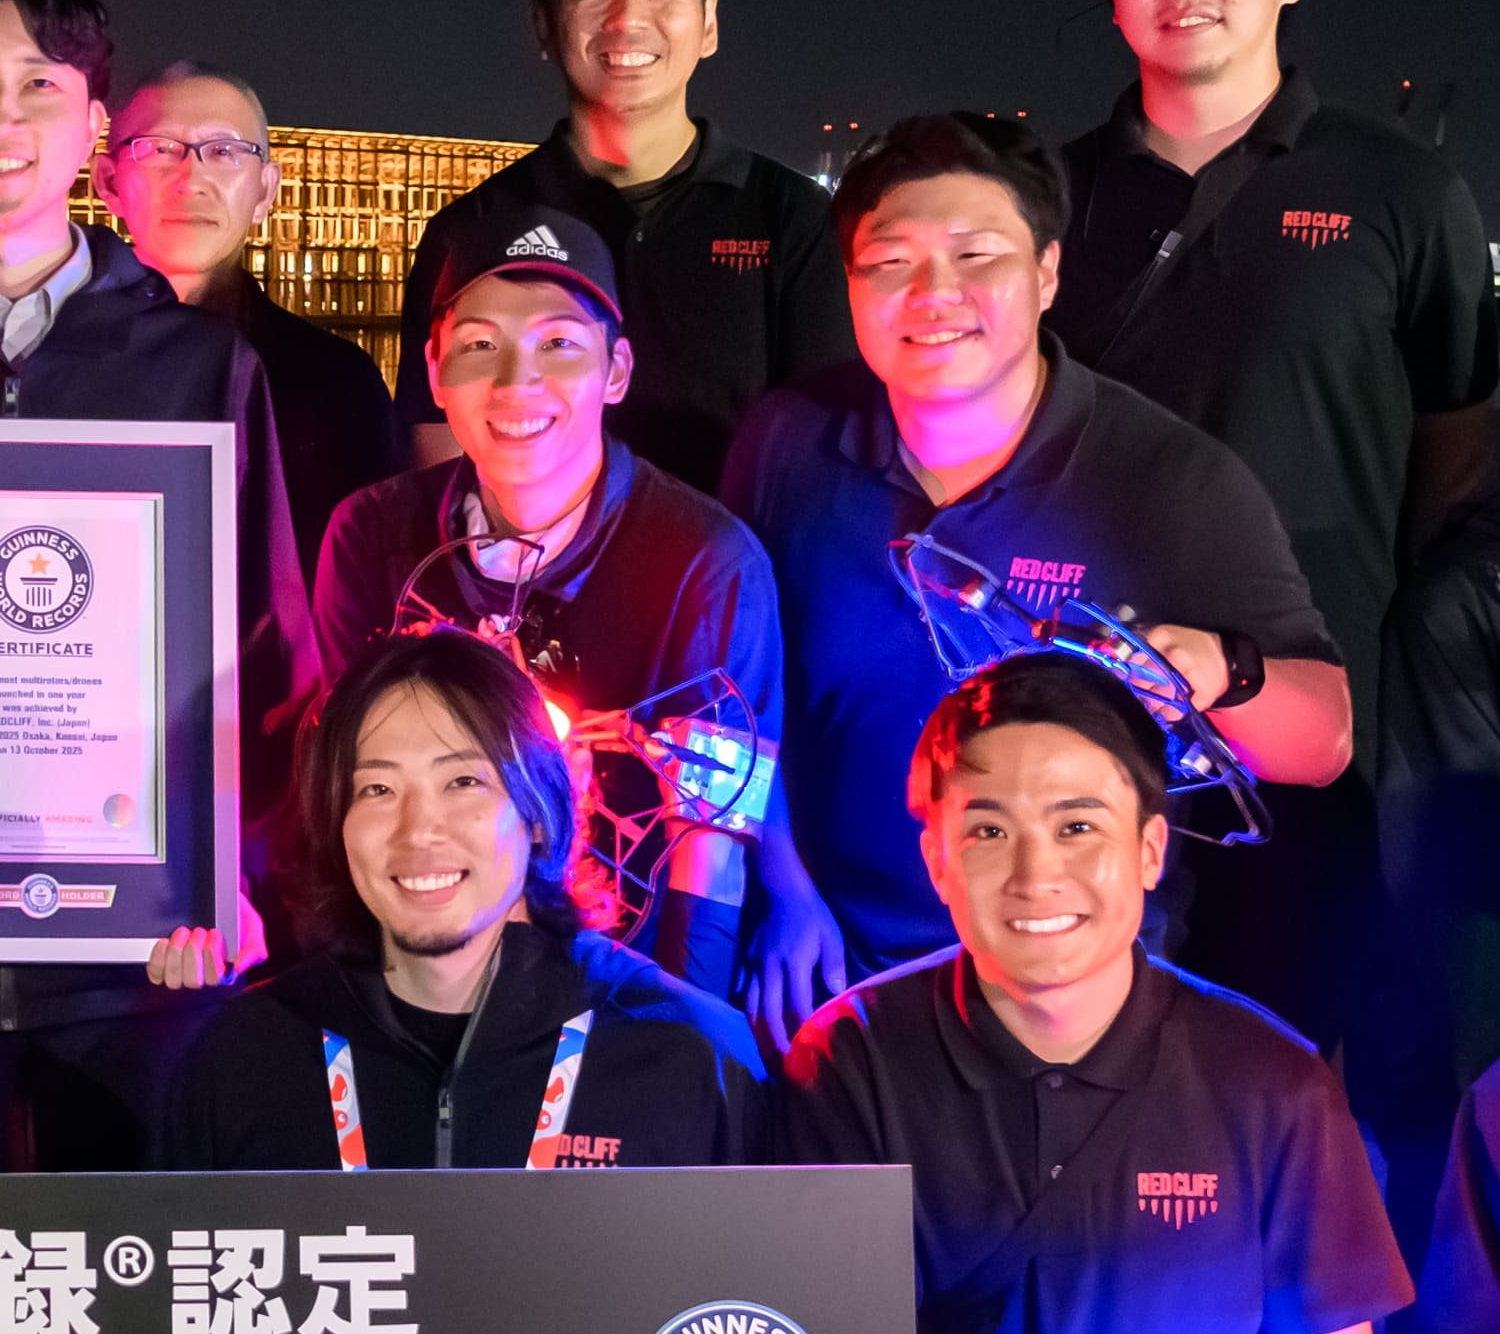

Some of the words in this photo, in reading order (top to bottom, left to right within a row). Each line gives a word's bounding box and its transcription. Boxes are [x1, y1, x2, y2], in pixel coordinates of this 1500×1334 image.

[505, 243, 568, 262] adidas
[0, 531, 79, 561] GUINNESS
[32, 572, 88, 628] RECORDS
[36, 689, 45, 698] in
[47, 691, 64, 699] one
[66, 691, 86, 700] year
[24, 704, 64, 713] achieved
[66, 705, 77, 714] by
[10, 746, 21, 754] 13
[23, 746, 58, 755] October
[61, 746, 83, 755] 2025
[60, 890, 105, 901] HOLDER
[572, 1134, 622, 1162] CLIFF
[1137, 1171, 1172, 1196] RED
[1173, 1171, 1219, 1198] CLIFF
